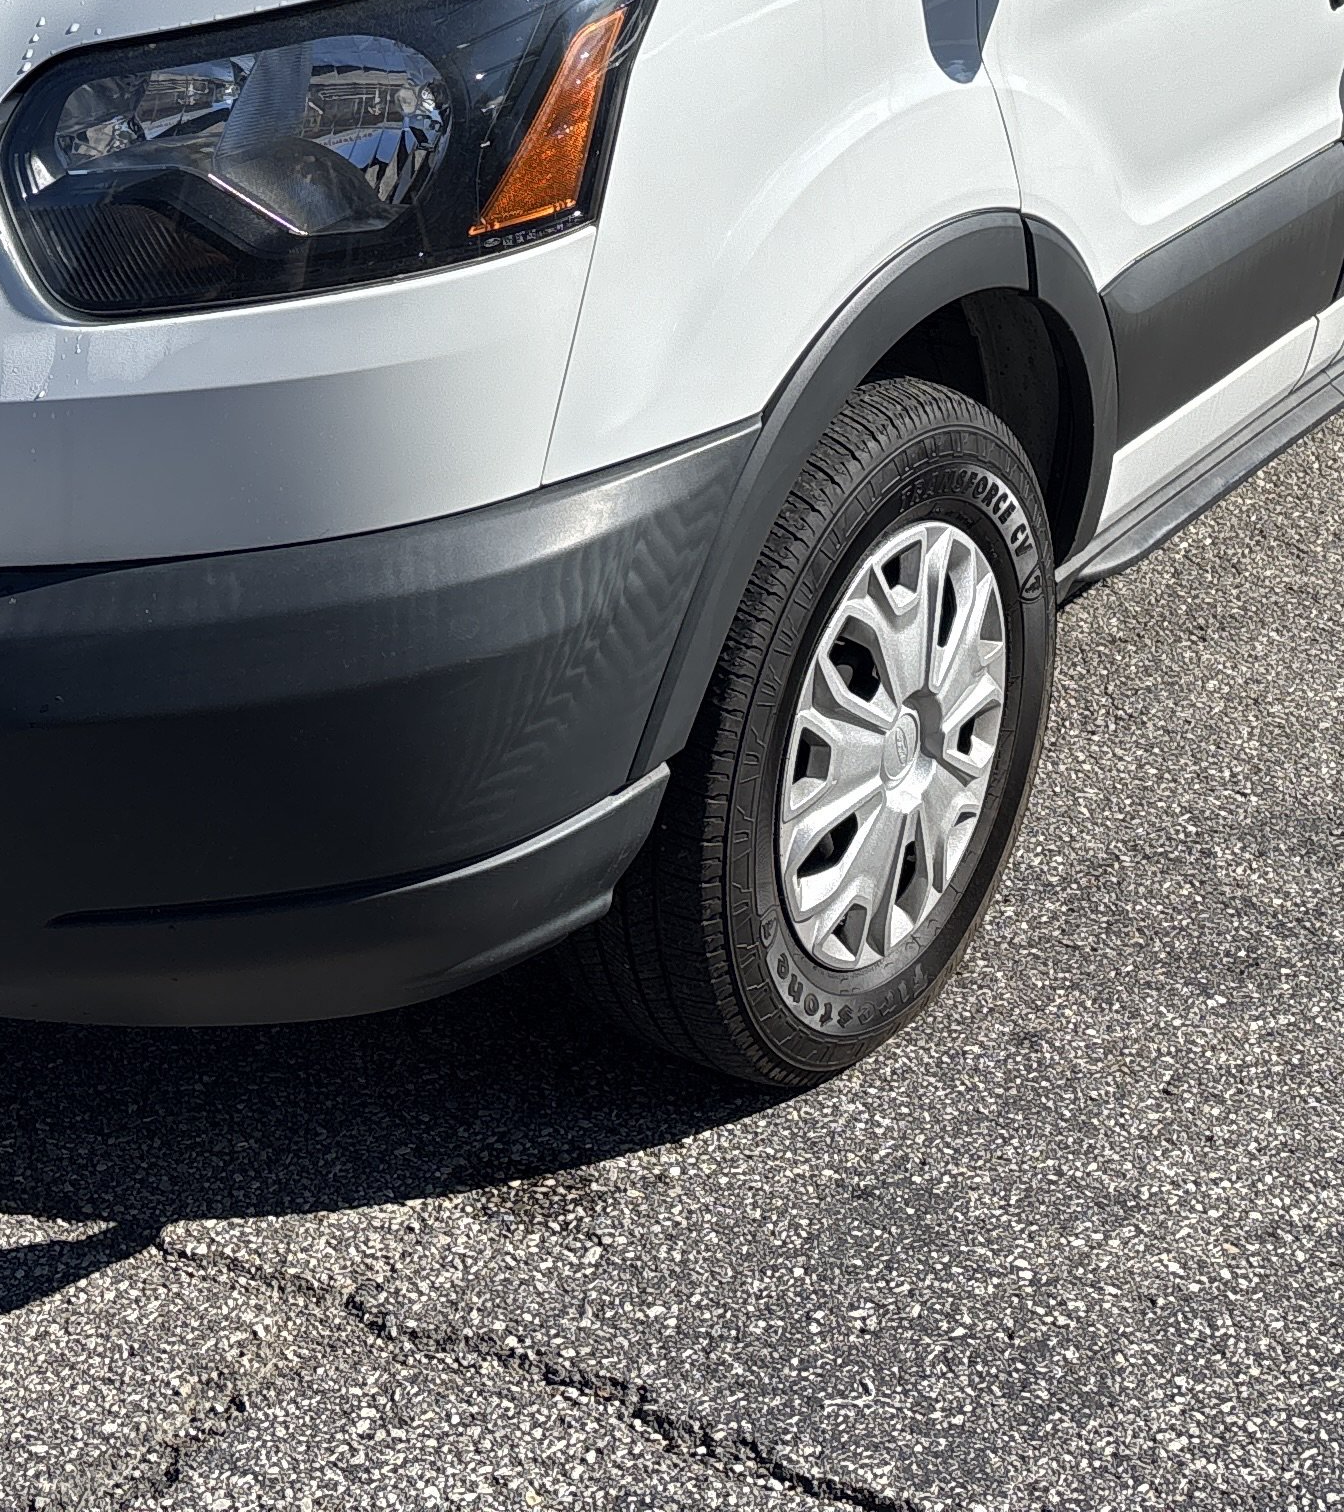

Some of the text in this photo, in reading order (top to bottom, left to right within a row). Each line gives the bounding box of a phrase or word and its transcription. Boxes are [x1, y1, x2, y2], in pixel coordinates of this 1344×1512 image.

[899, 468, 1016, 524] TRANSFORCE
[1010, 524, 1034, 557] CV
[776, 953, 929, 1028] Firestone
